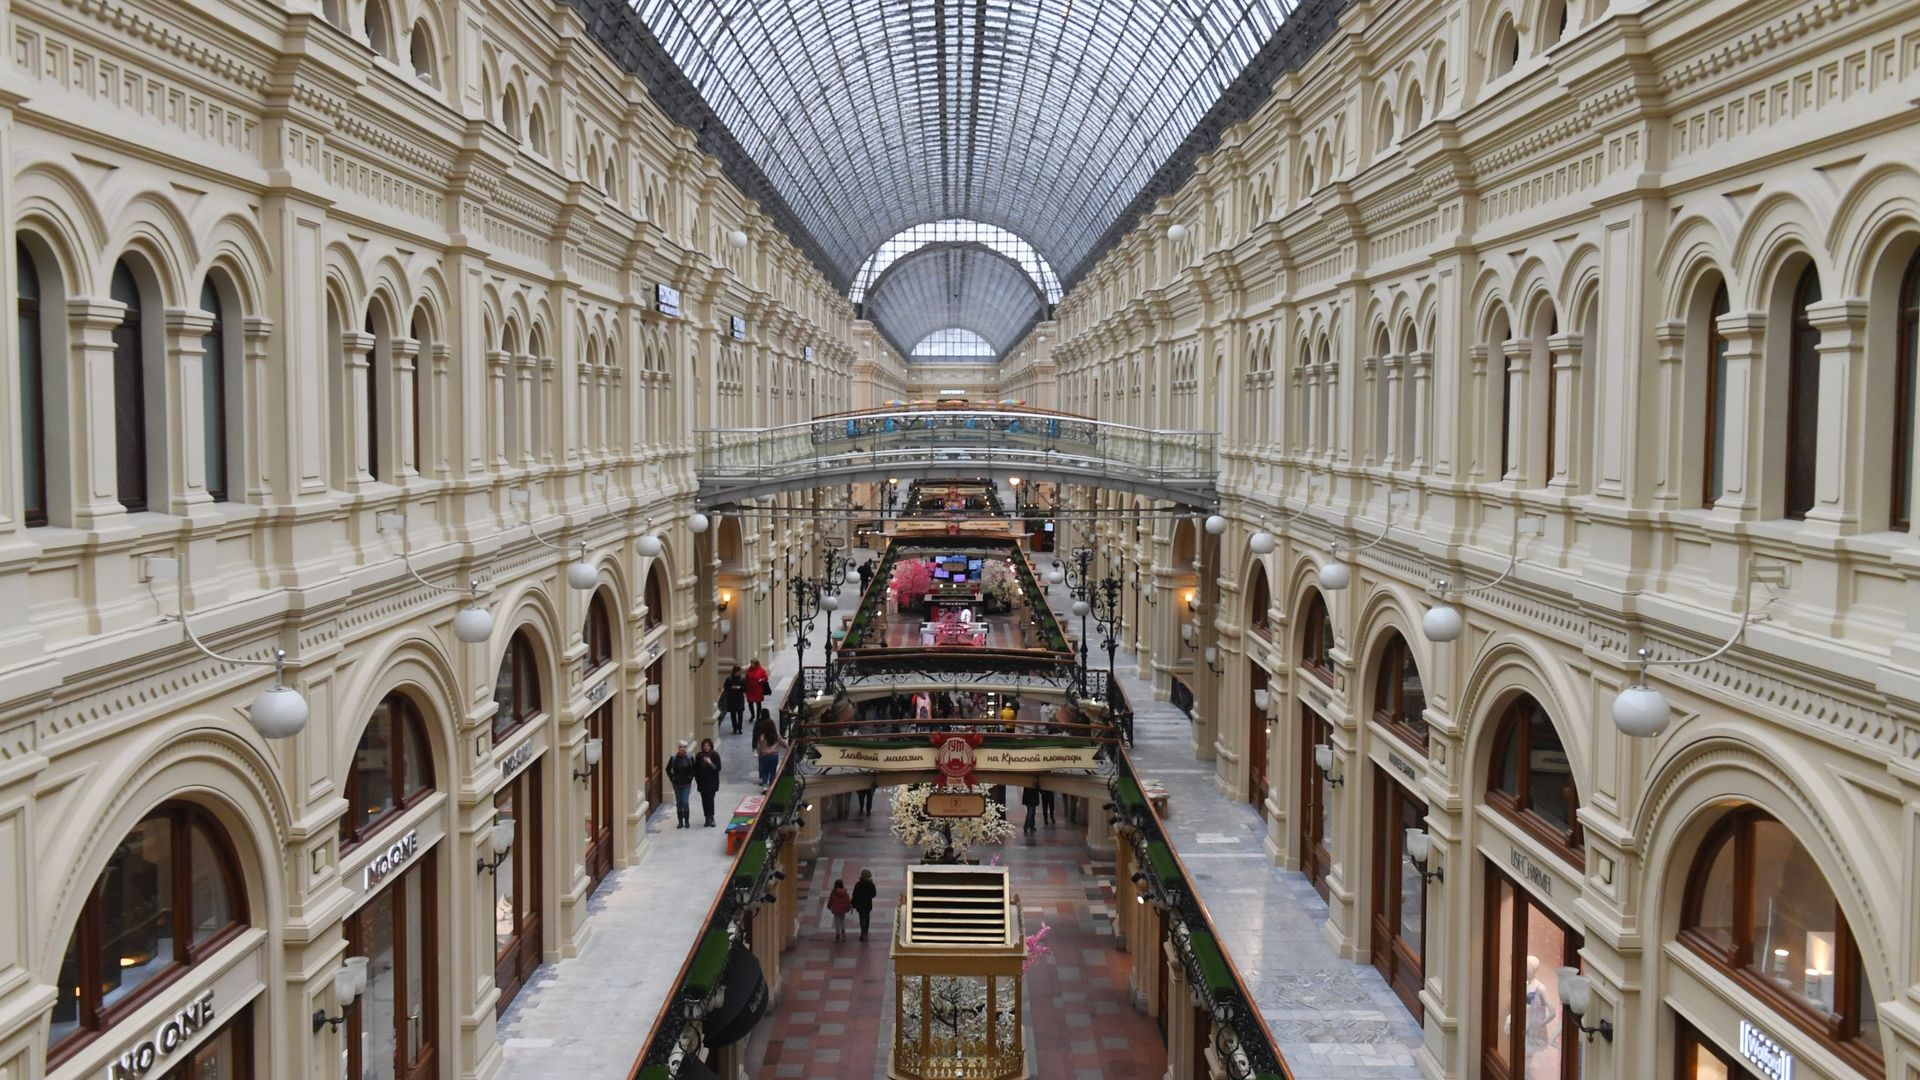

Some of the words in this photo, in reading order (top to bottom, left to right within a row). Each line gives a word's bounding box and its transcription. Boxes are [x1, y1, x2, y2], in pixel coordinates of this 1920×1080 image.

[839, 747, 879, 762] Главный
[1001, 752, 1040, 765] Красной
[1042, 754, 1082, 764] площади
[387, 829, 418, 869] ONE
[155, 989, 215, 1056] ONE
